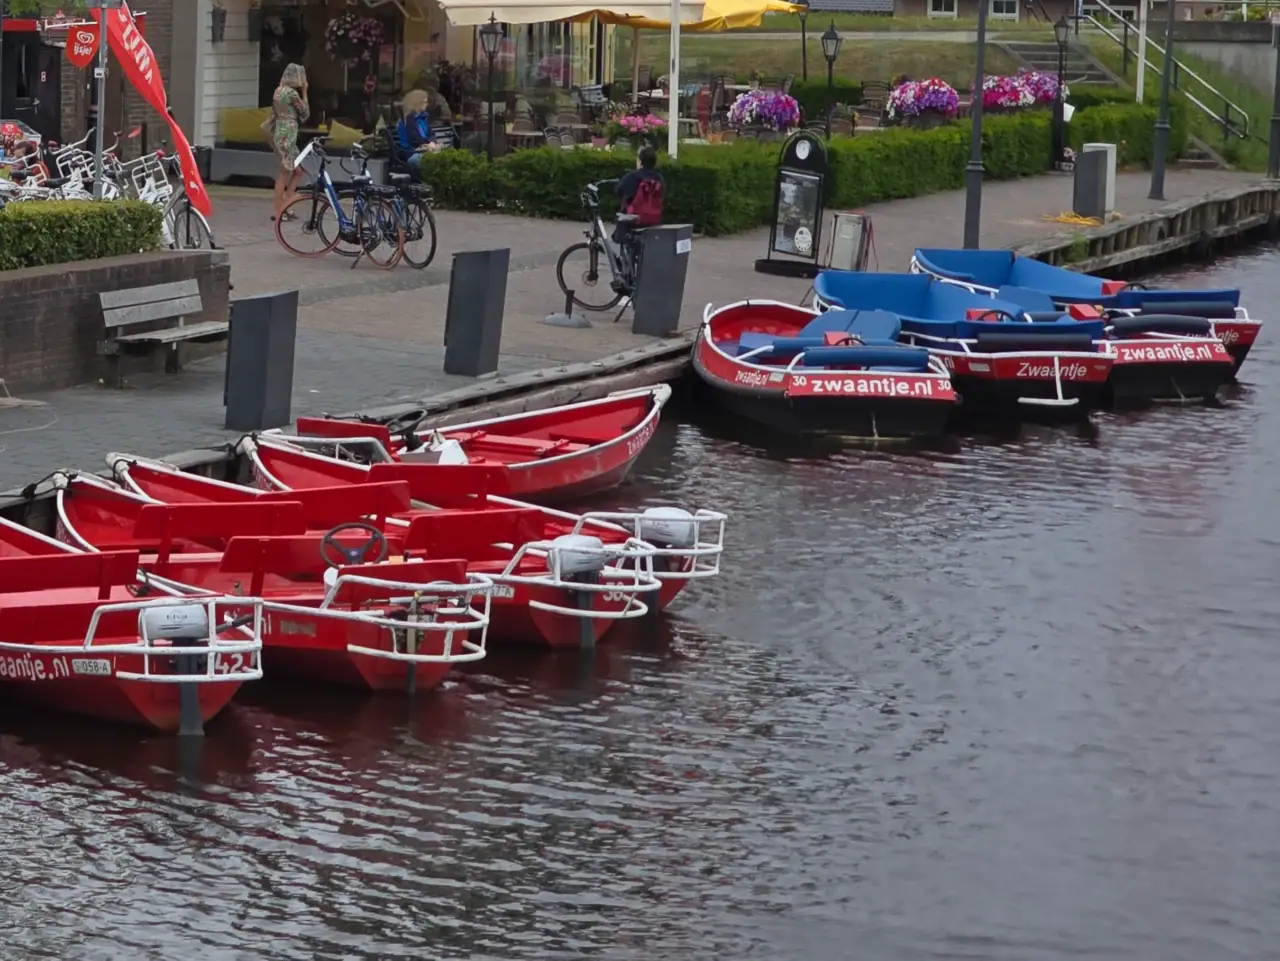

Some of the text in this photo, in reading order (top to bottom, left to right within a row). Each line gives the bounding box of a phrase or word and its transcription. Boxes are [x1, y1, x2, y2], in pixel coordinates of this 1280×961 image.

[1121, 343, 1213, 361] zwaantje.nl
[735, 369, 770, 387] zwaantje.nl
[1016, 362, 1088, 380] Zwaantje
[792, 375, 807, 387] 30
[811, 378, 933, 397] zwaantje.nl
[937, 380, 952, 391] 30
